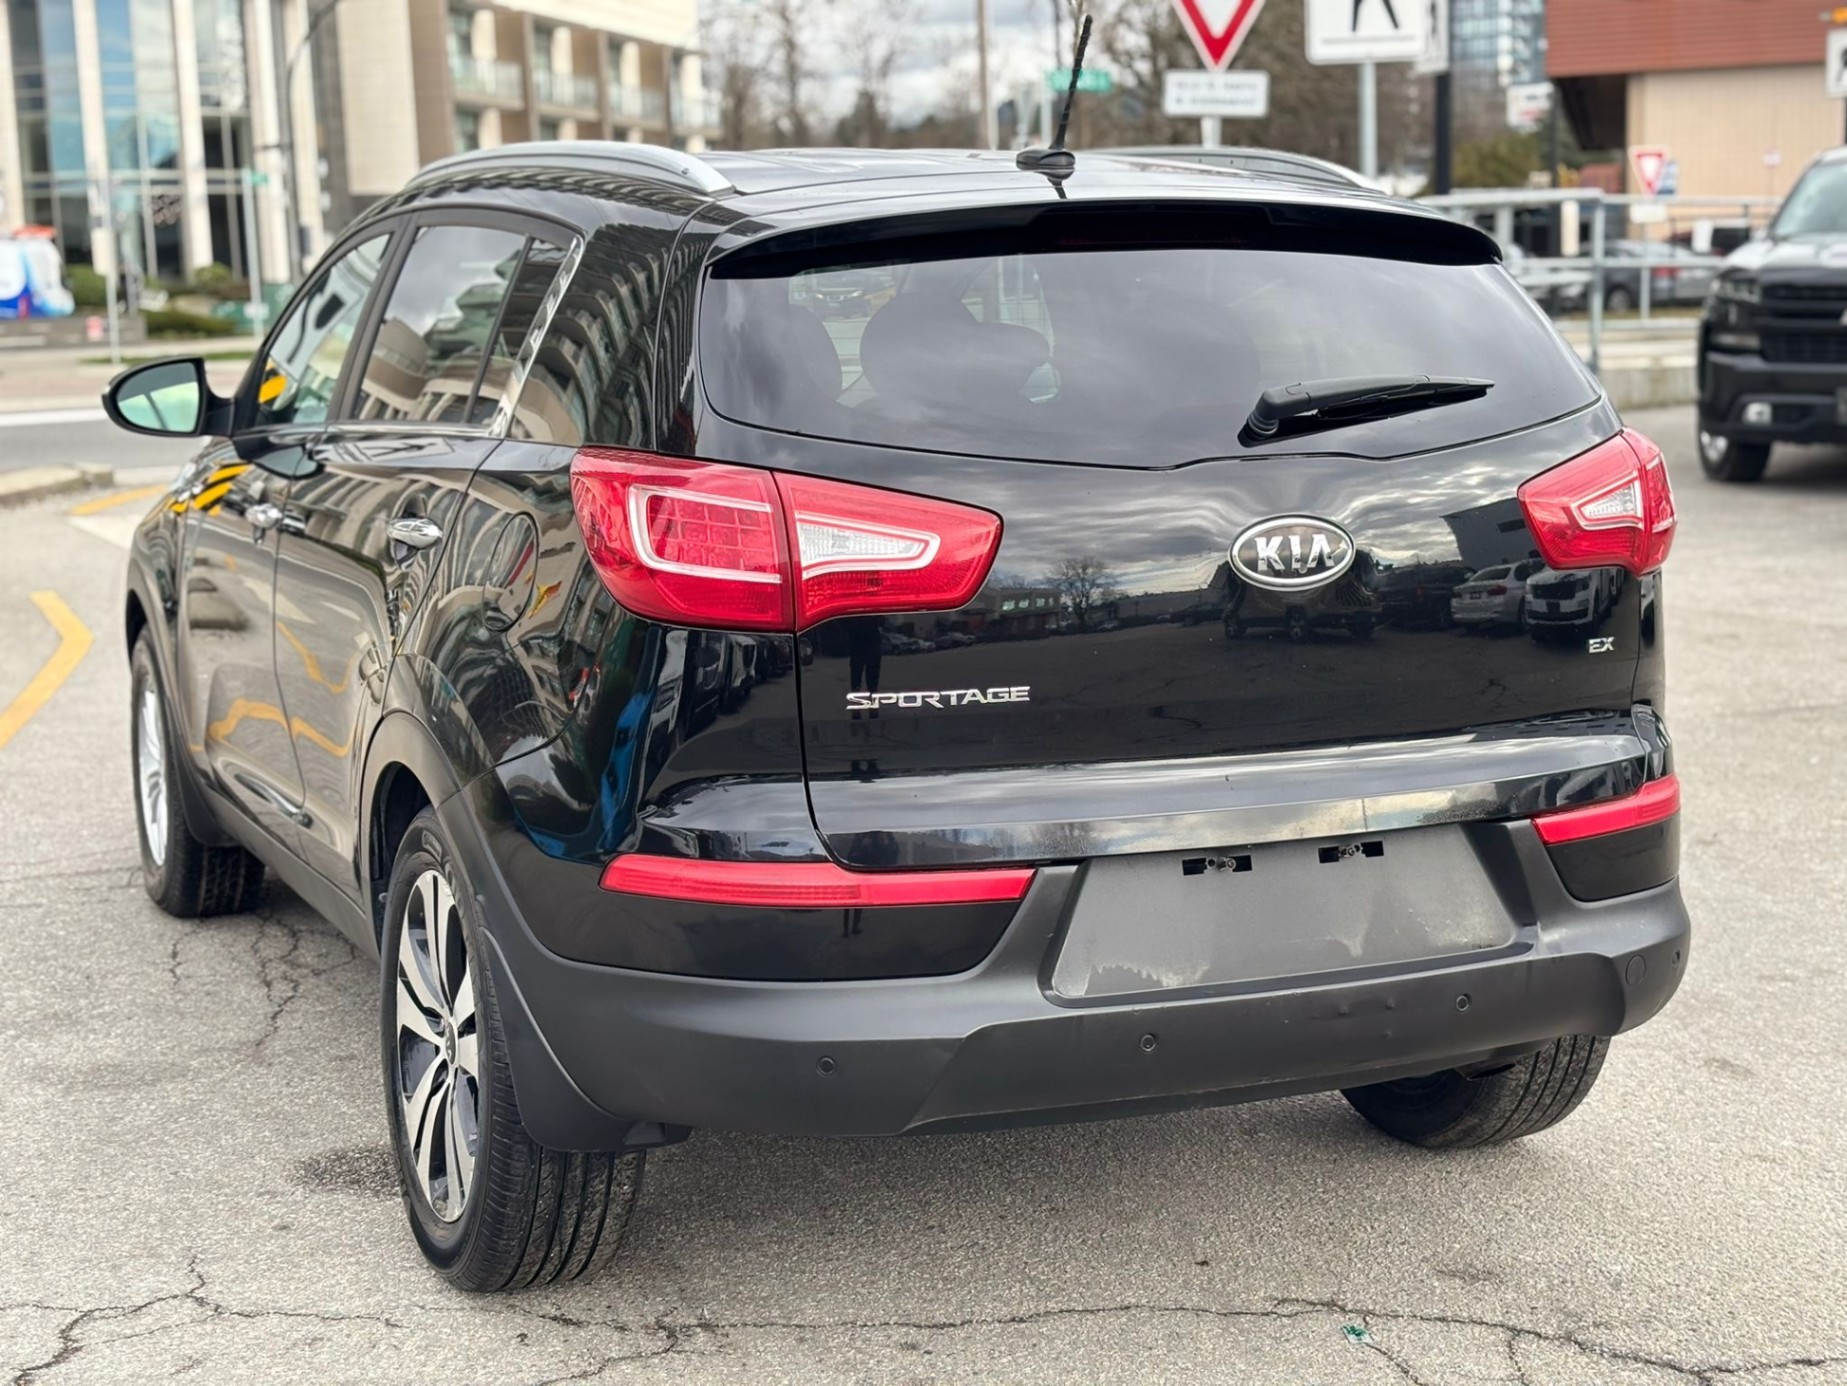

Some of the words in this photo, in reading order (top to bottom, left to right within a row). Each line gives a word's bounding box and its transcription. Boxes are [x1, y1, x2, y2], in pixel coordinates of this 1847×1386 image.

[1254, 534, 1335, 571] KIA
[1589, 636, 1614, 653] EX
[846, 686, 1030, 710] SPORTAGE
